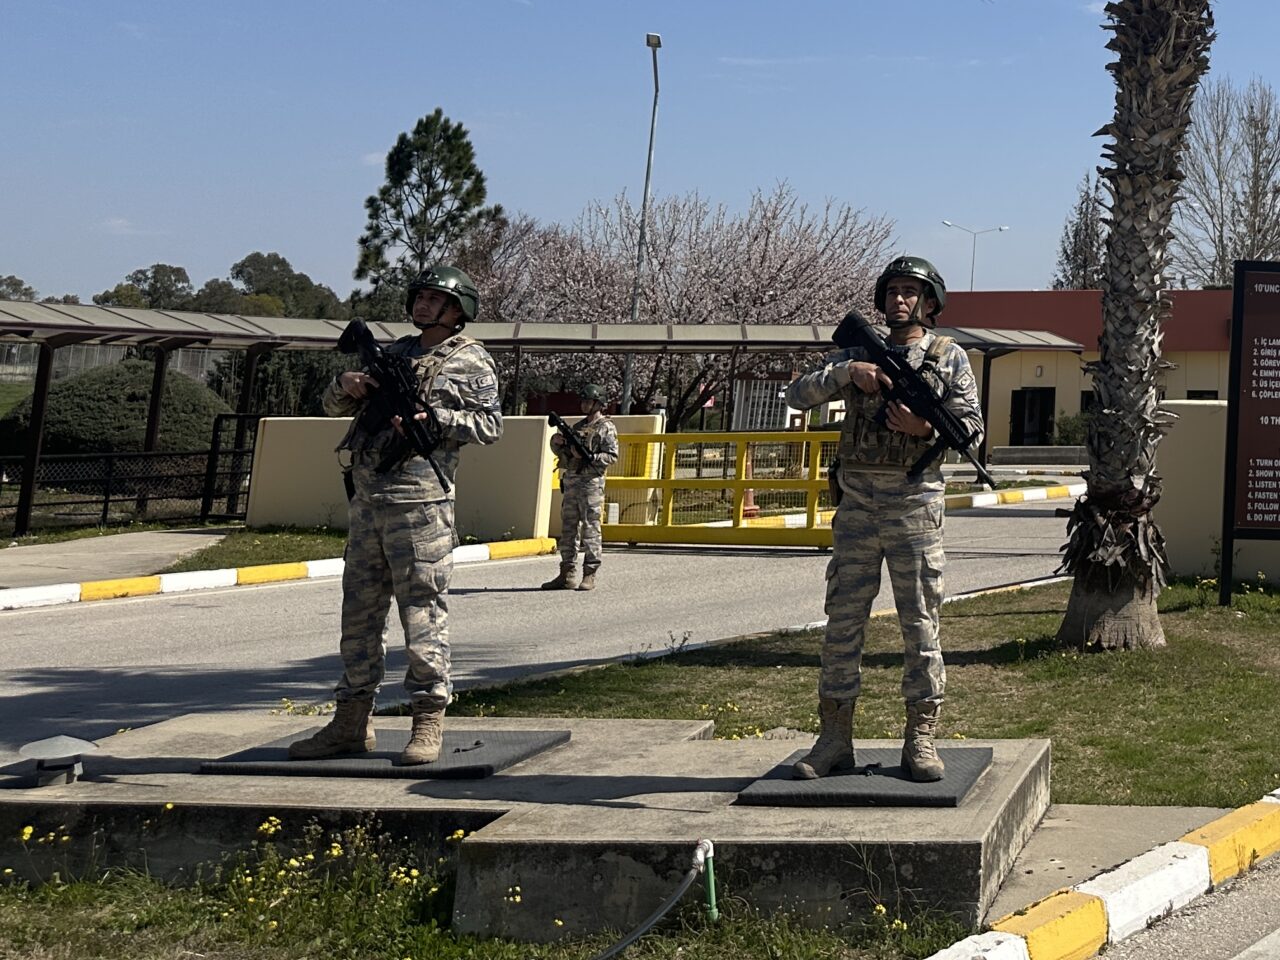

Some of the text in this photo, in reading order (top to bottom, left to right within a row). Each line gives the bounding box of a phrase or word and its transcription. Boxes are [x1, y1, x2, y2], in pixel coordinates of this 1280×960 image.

[1260, 417, 1269, 425] 10
[1271, 417, 1280, 425] TH
[1256, 459, 1272, 467] TURN
[1256, 470, 1274, 478] SHOW
[1255, 481, 1276, 489] LISTEN
[1254, 503, 1279, 511] FOLLOW
[1264, 514, 1277, 522] NOT
